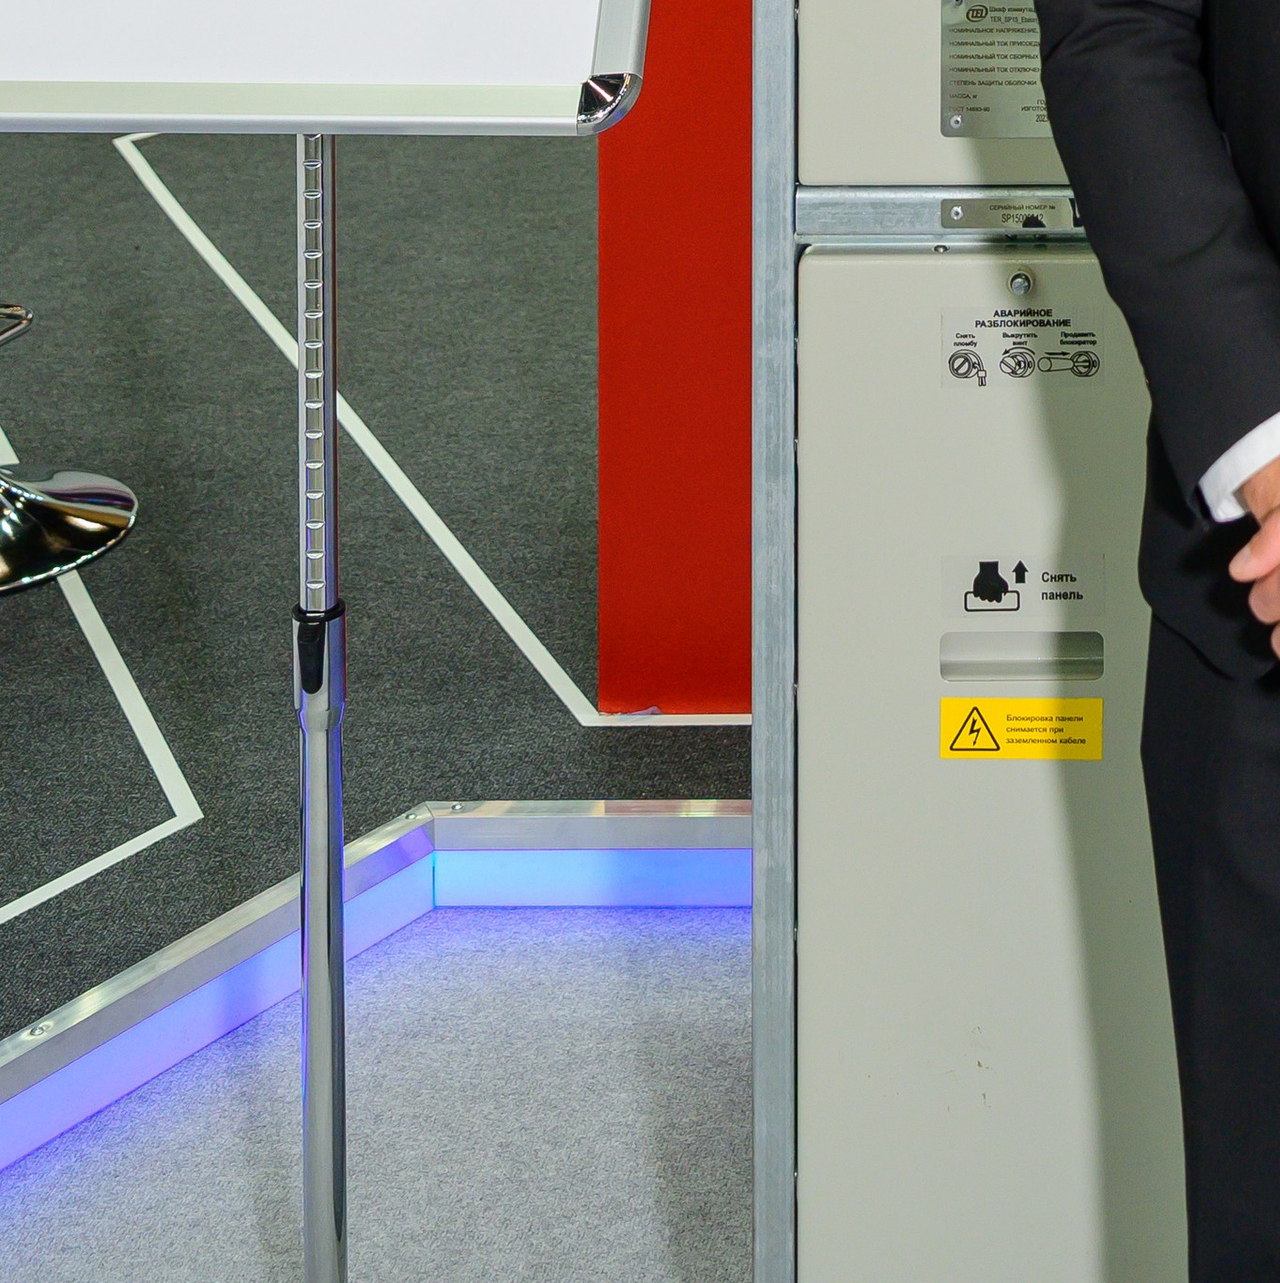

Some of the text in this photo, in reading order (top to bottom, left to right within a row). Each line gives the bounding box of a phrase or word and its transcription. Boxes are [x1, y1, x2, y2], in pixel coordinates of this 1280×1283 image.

[993, 308, 1052, 318] АВАРИЙНОЕ
[975, 319, 1071, 328] РАЗБЛОКИРОВАНИЕ
[1042, 572, 1077, 583] Снять
[1042, 590, 1083, 600] панель
[1007, 714, 1053, 722] Блокировка
